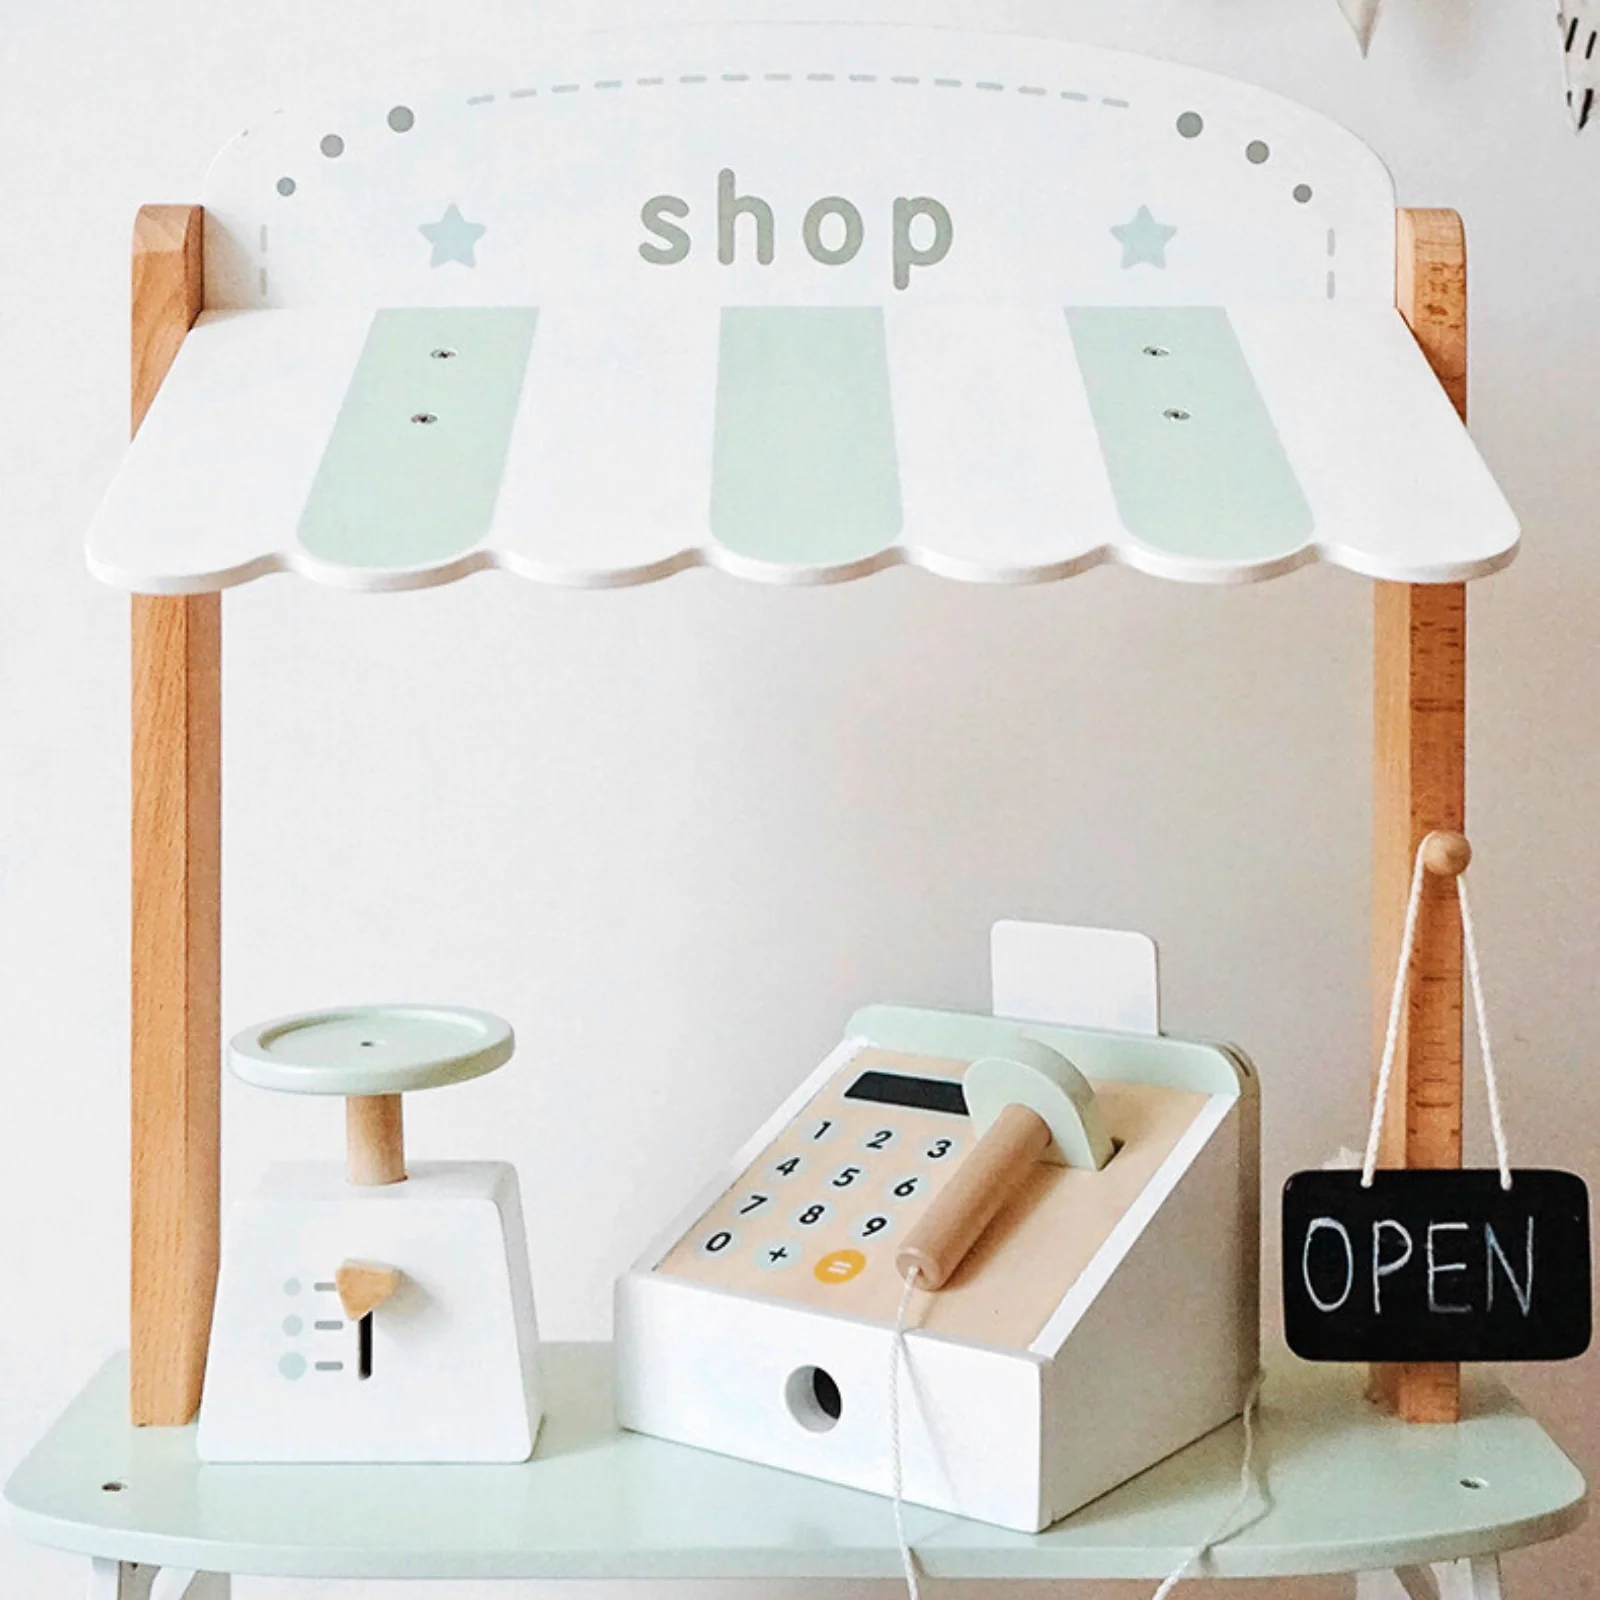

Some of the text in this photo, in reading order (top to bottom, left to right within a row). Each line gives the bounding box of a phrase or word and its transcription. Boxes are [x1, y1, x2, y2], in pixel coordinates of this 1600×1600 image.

[638, 167, 954, 291] shop
[813, 1120, 953, 1159] 1 2 3
[775, 1157, 918, 1197] 4 5 6
[739, 1194, 888, 1237] 7 8 9
[705, 1231, 732, 1252] 0
[1302, 1215, 1535, 1318] OPEN
